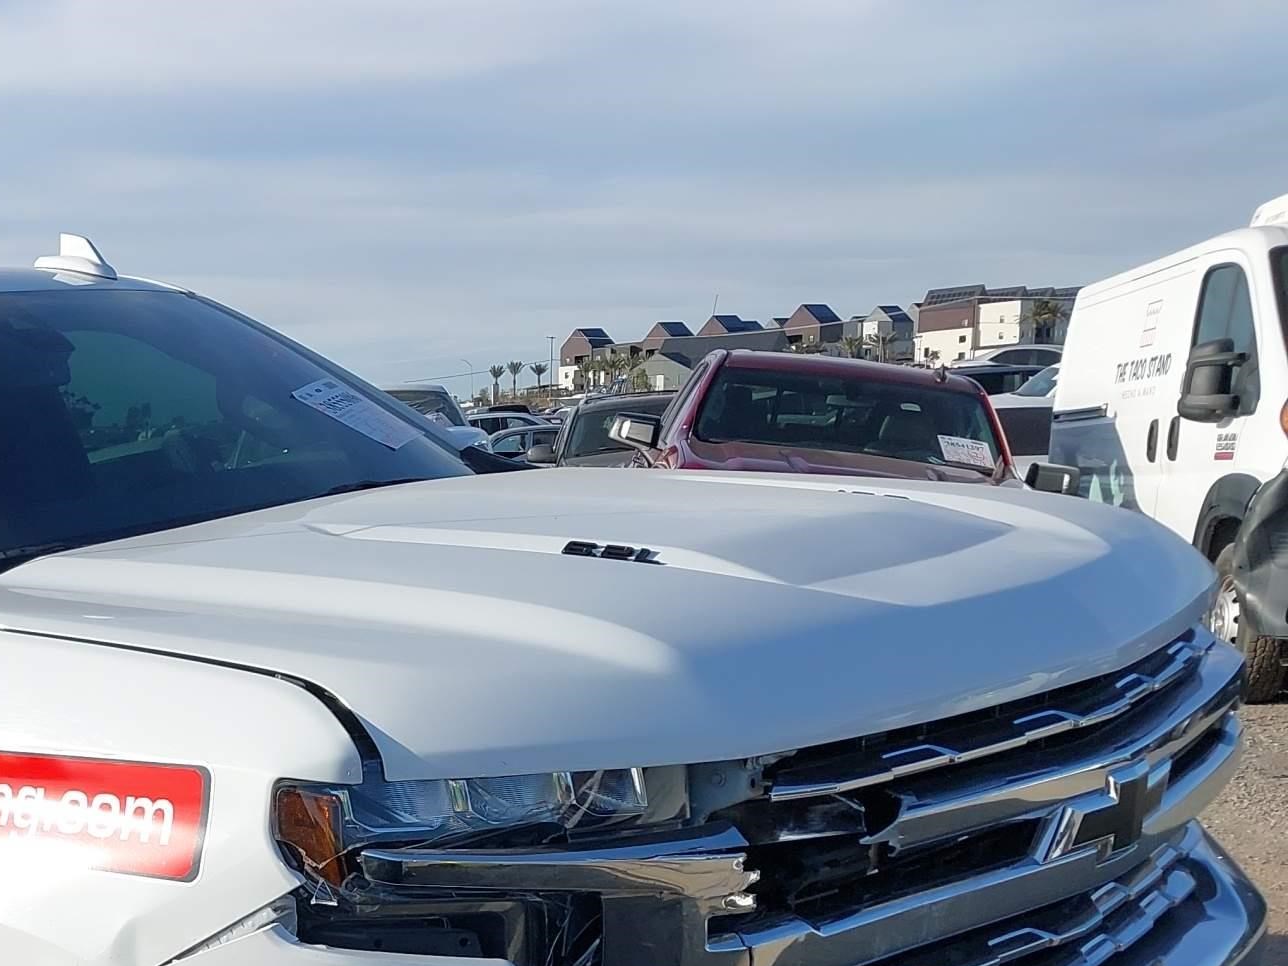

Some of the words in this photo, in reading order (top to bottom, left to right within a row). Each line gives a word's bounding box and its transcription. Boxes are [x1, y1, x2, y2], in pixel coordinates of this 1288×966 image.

[1115, 363, 1129, 384] THE
[1129, 359, 1147, 381] TACO
[1147, 353, 1172, 379] STAND
